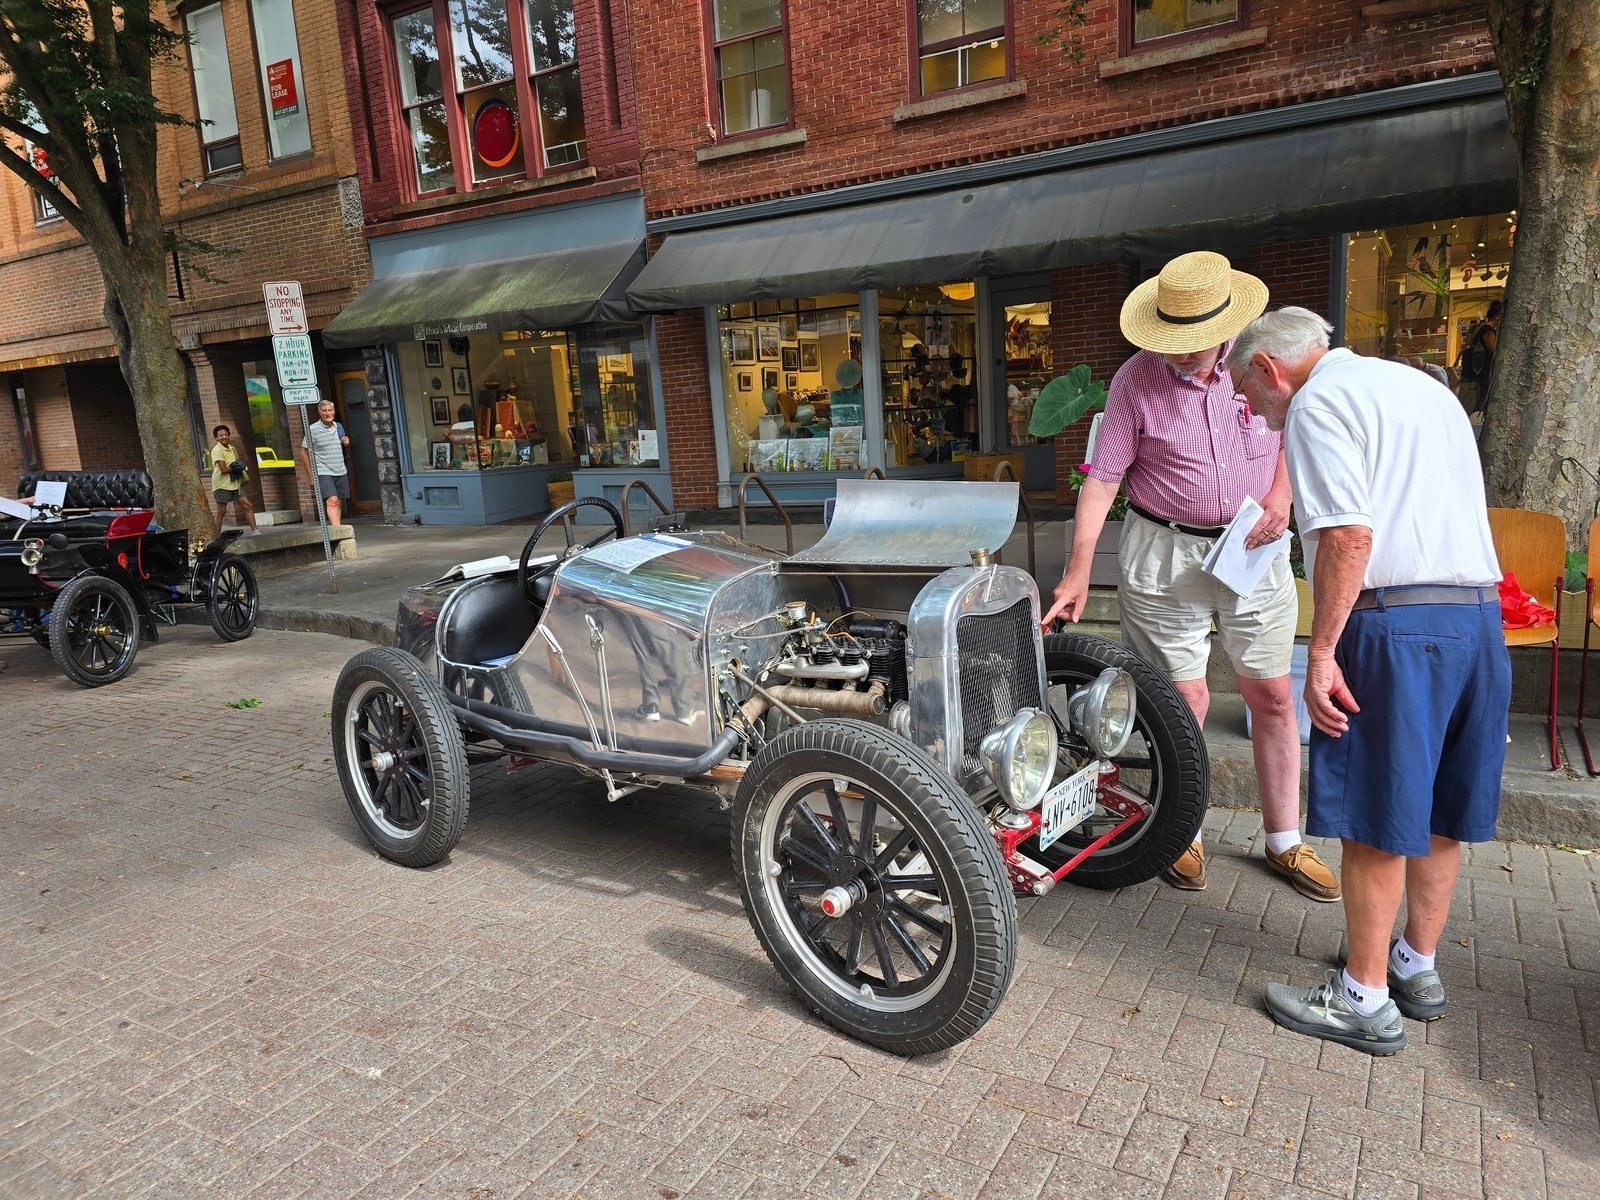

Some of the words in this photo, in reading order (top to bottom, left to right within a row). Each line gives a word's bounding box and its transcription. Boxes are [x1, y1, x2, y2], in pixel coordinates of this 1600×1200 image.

[271, 84, 282, 92] FOR
[272, 89, 288, 99] LEASE
[276, 286, 290, 296] NO
[269, 298, 301, 308] STOPPING
[459, 321, 487, 332] Cooperative
[278, 341, 284, 349] 2
[286, 339, 306, 348] HOUR
[278, 350, 310, 359] PARKING
[282, 360, 309, 368] 9AM-6PM
[1058, 782, 1072, 797] NEW
[1072, 775, 1086, 788] YORK
